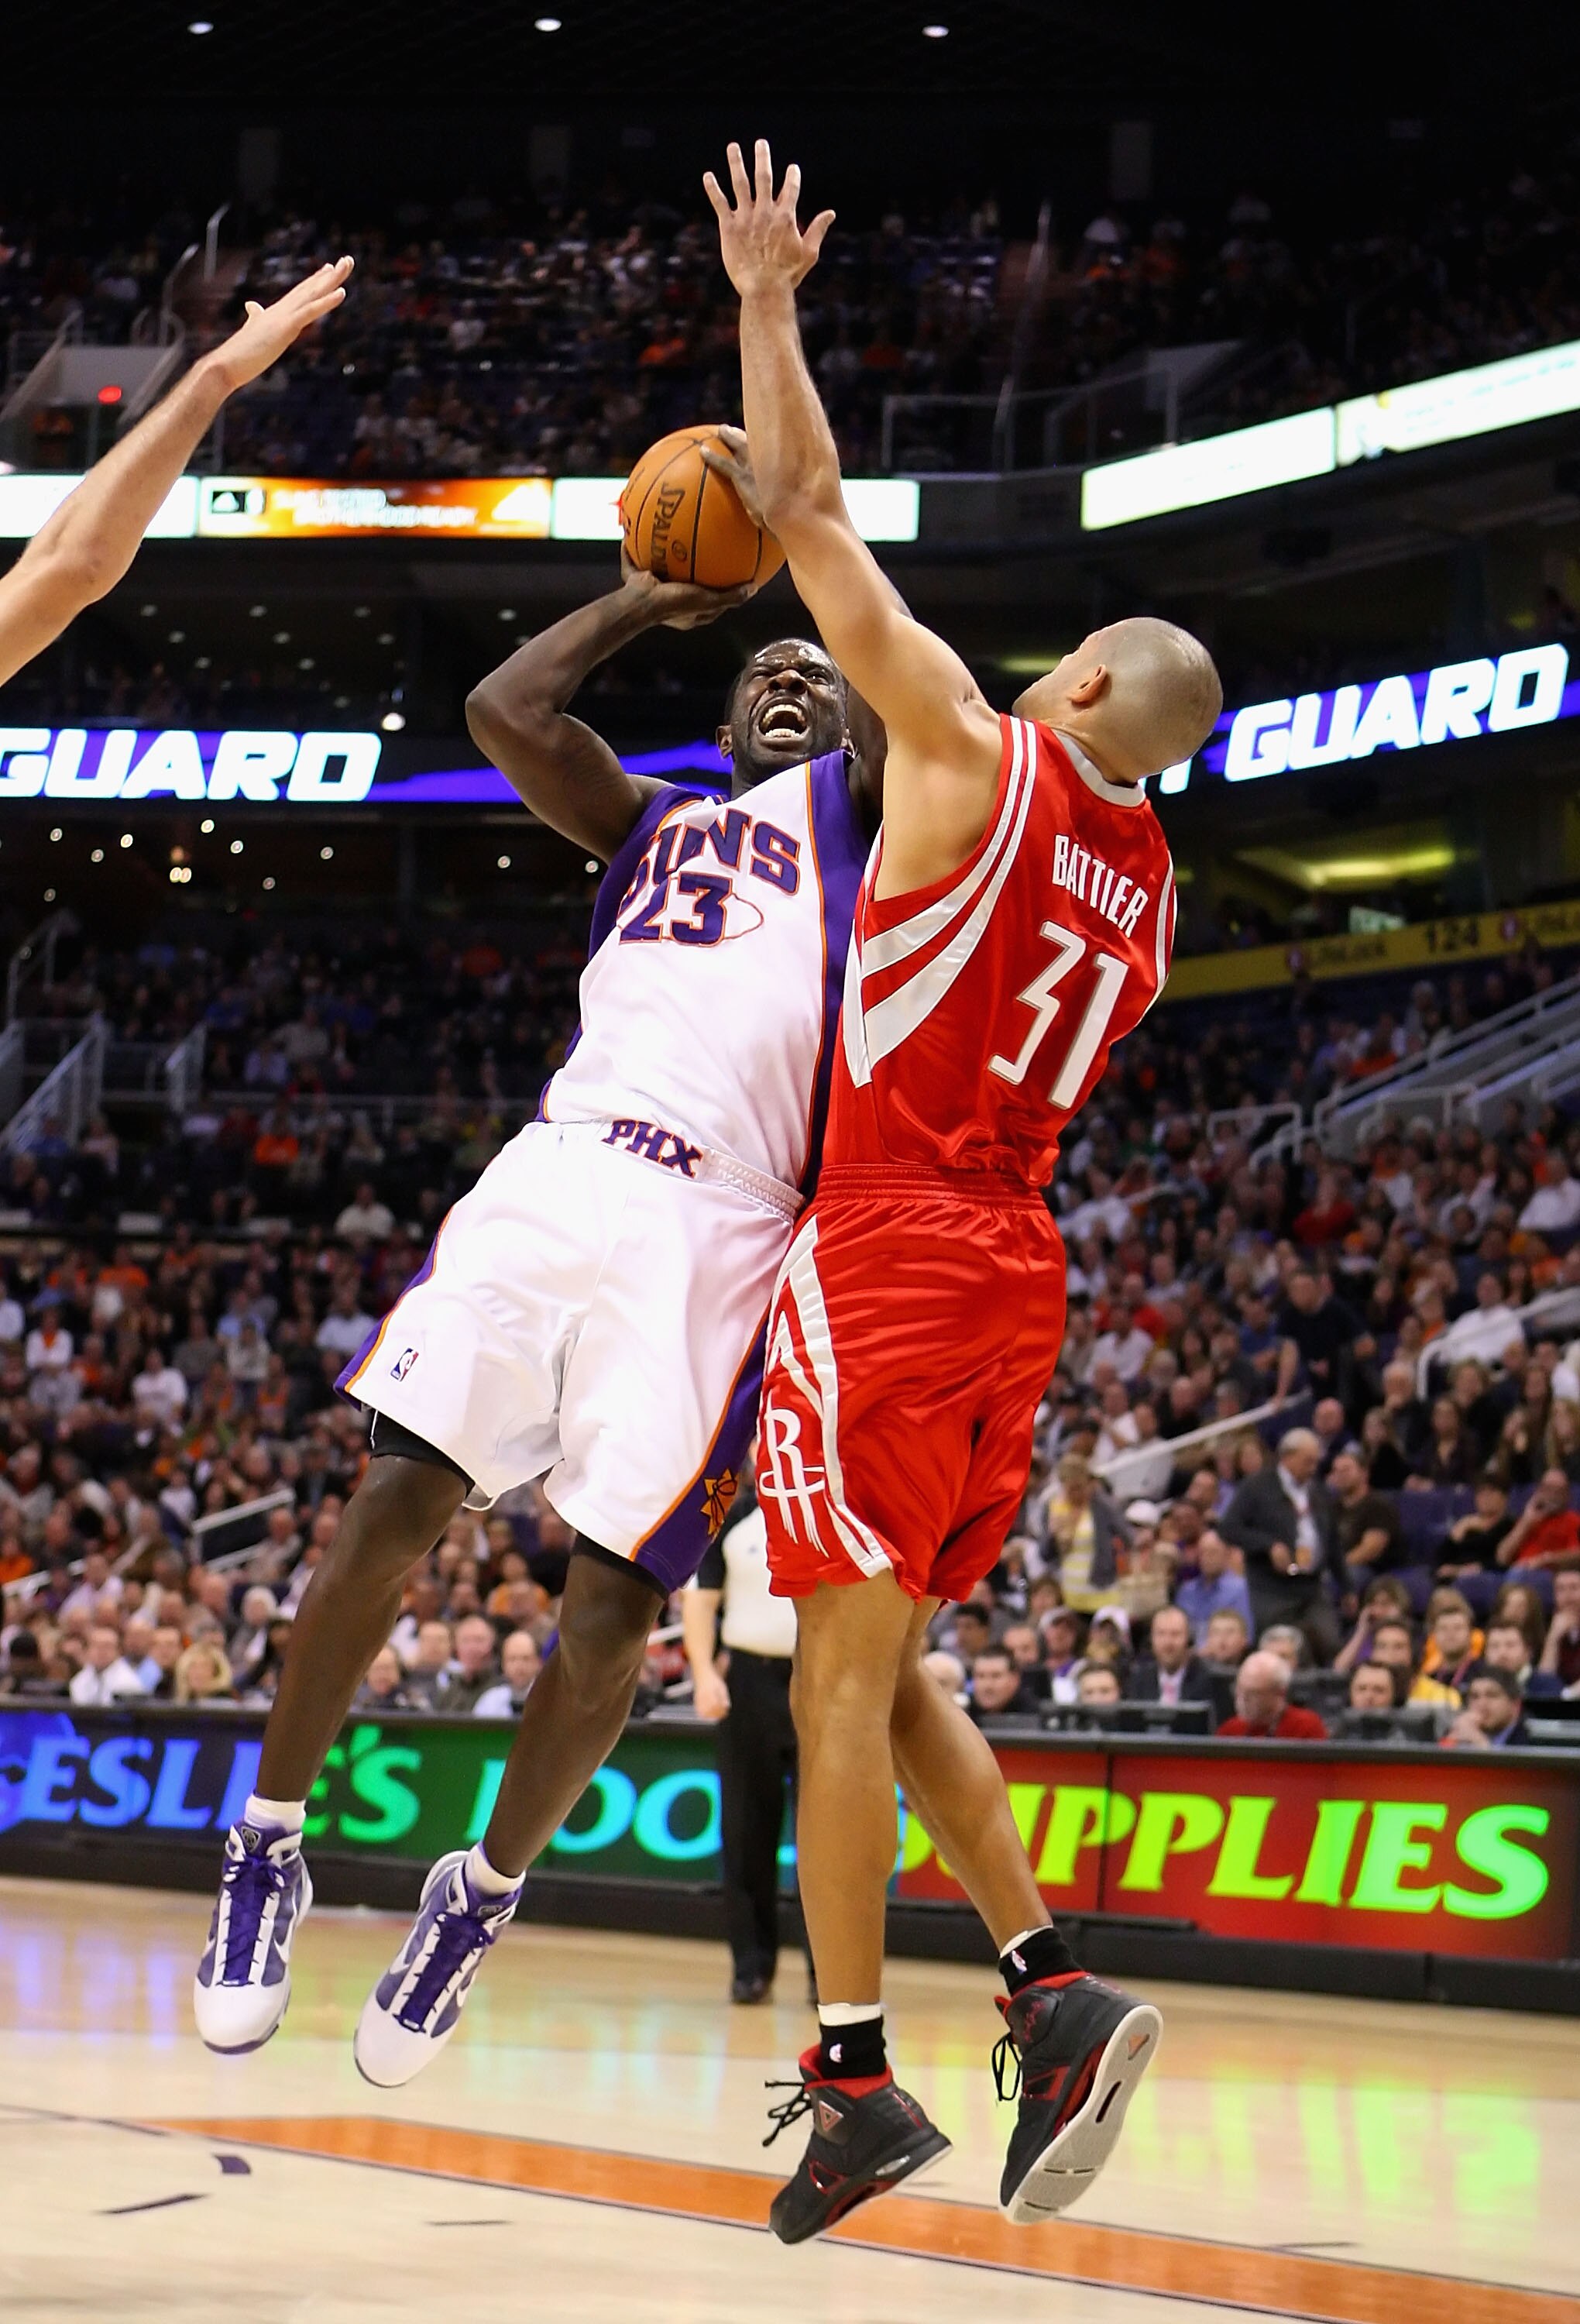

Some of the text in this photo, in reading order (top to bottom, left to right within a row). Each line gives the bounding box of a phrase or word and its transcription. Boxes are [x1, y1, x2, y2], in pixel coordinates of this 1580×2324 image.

[1224, 642, 1569, 782] GUARD
[619, 871, 727, 947] 23
[1051, 834, 1149, 938] BATTIER
[988, 920, 1129, 1110] 31
[600, 1119, 703, 1179] PHX
